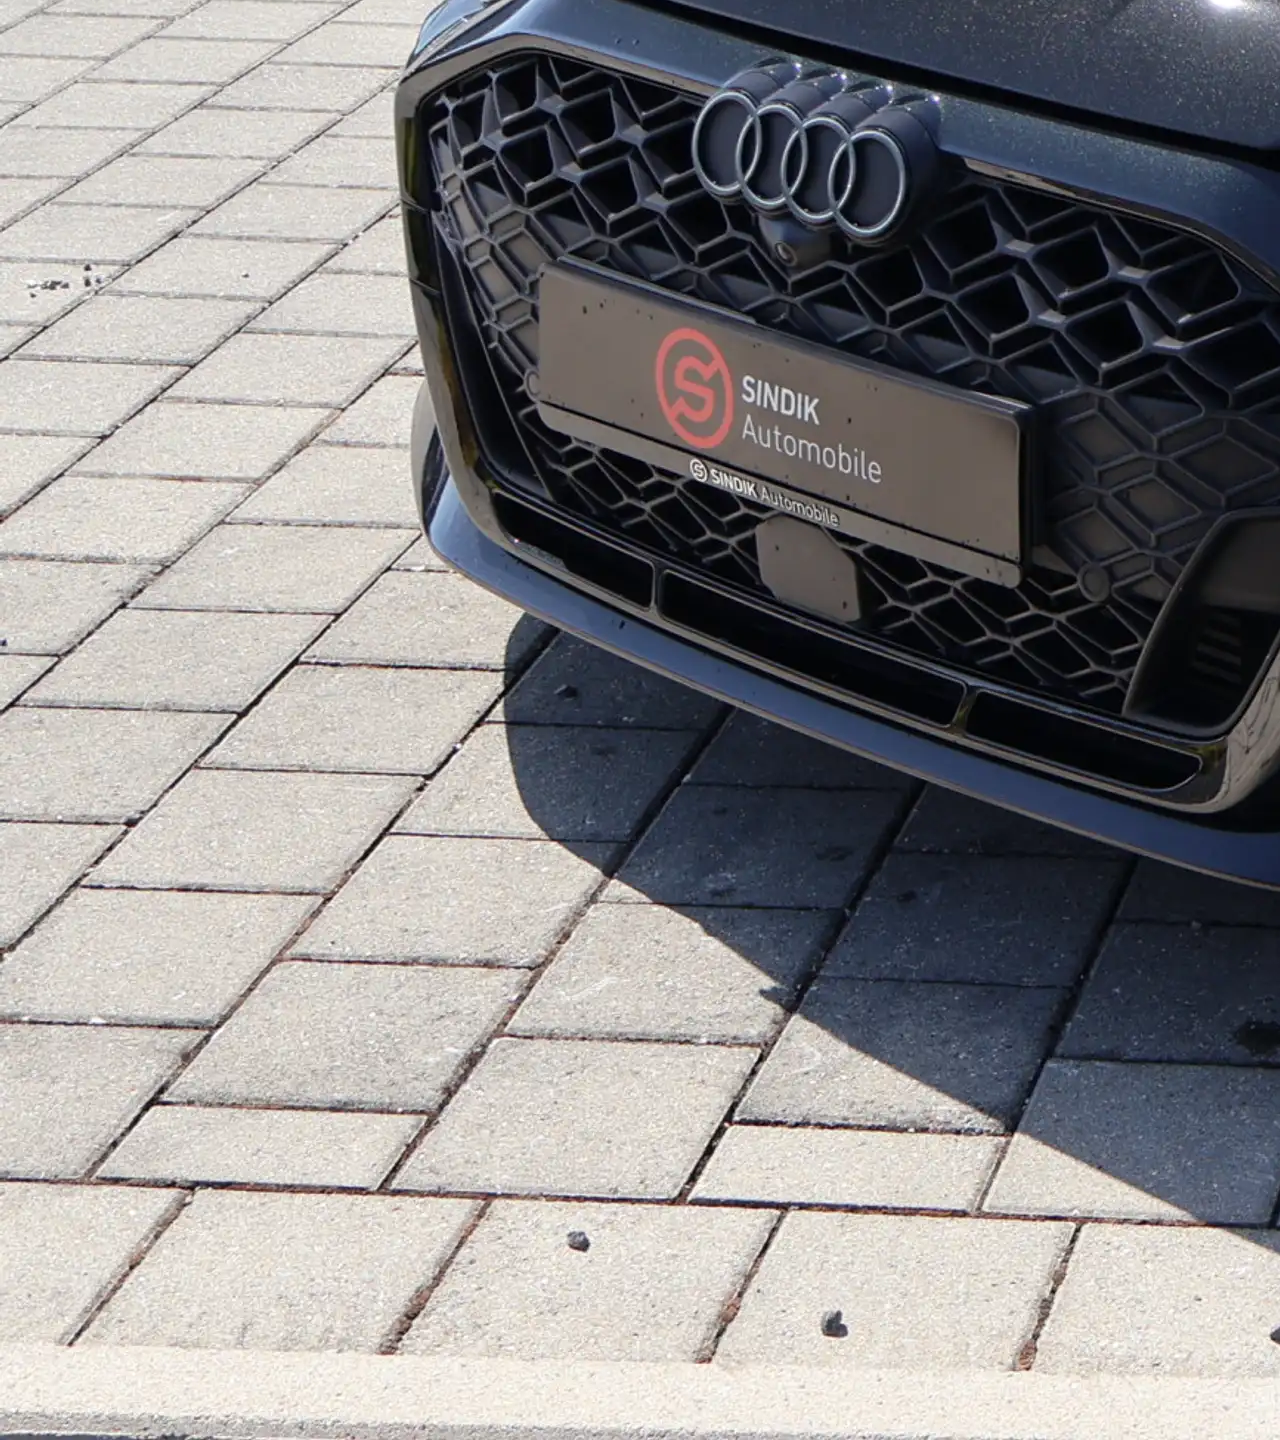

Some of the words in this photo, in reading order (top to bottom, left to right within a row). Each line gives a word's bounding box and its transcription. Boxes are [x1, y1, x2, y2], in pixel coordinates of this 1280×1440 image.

[742, 375, 820, 425] SINDIK
[742, 414, 882, 483] Automobile
[711, 468, 757, 498] SINDIK
[761, 488, 839, 527] Automobile
